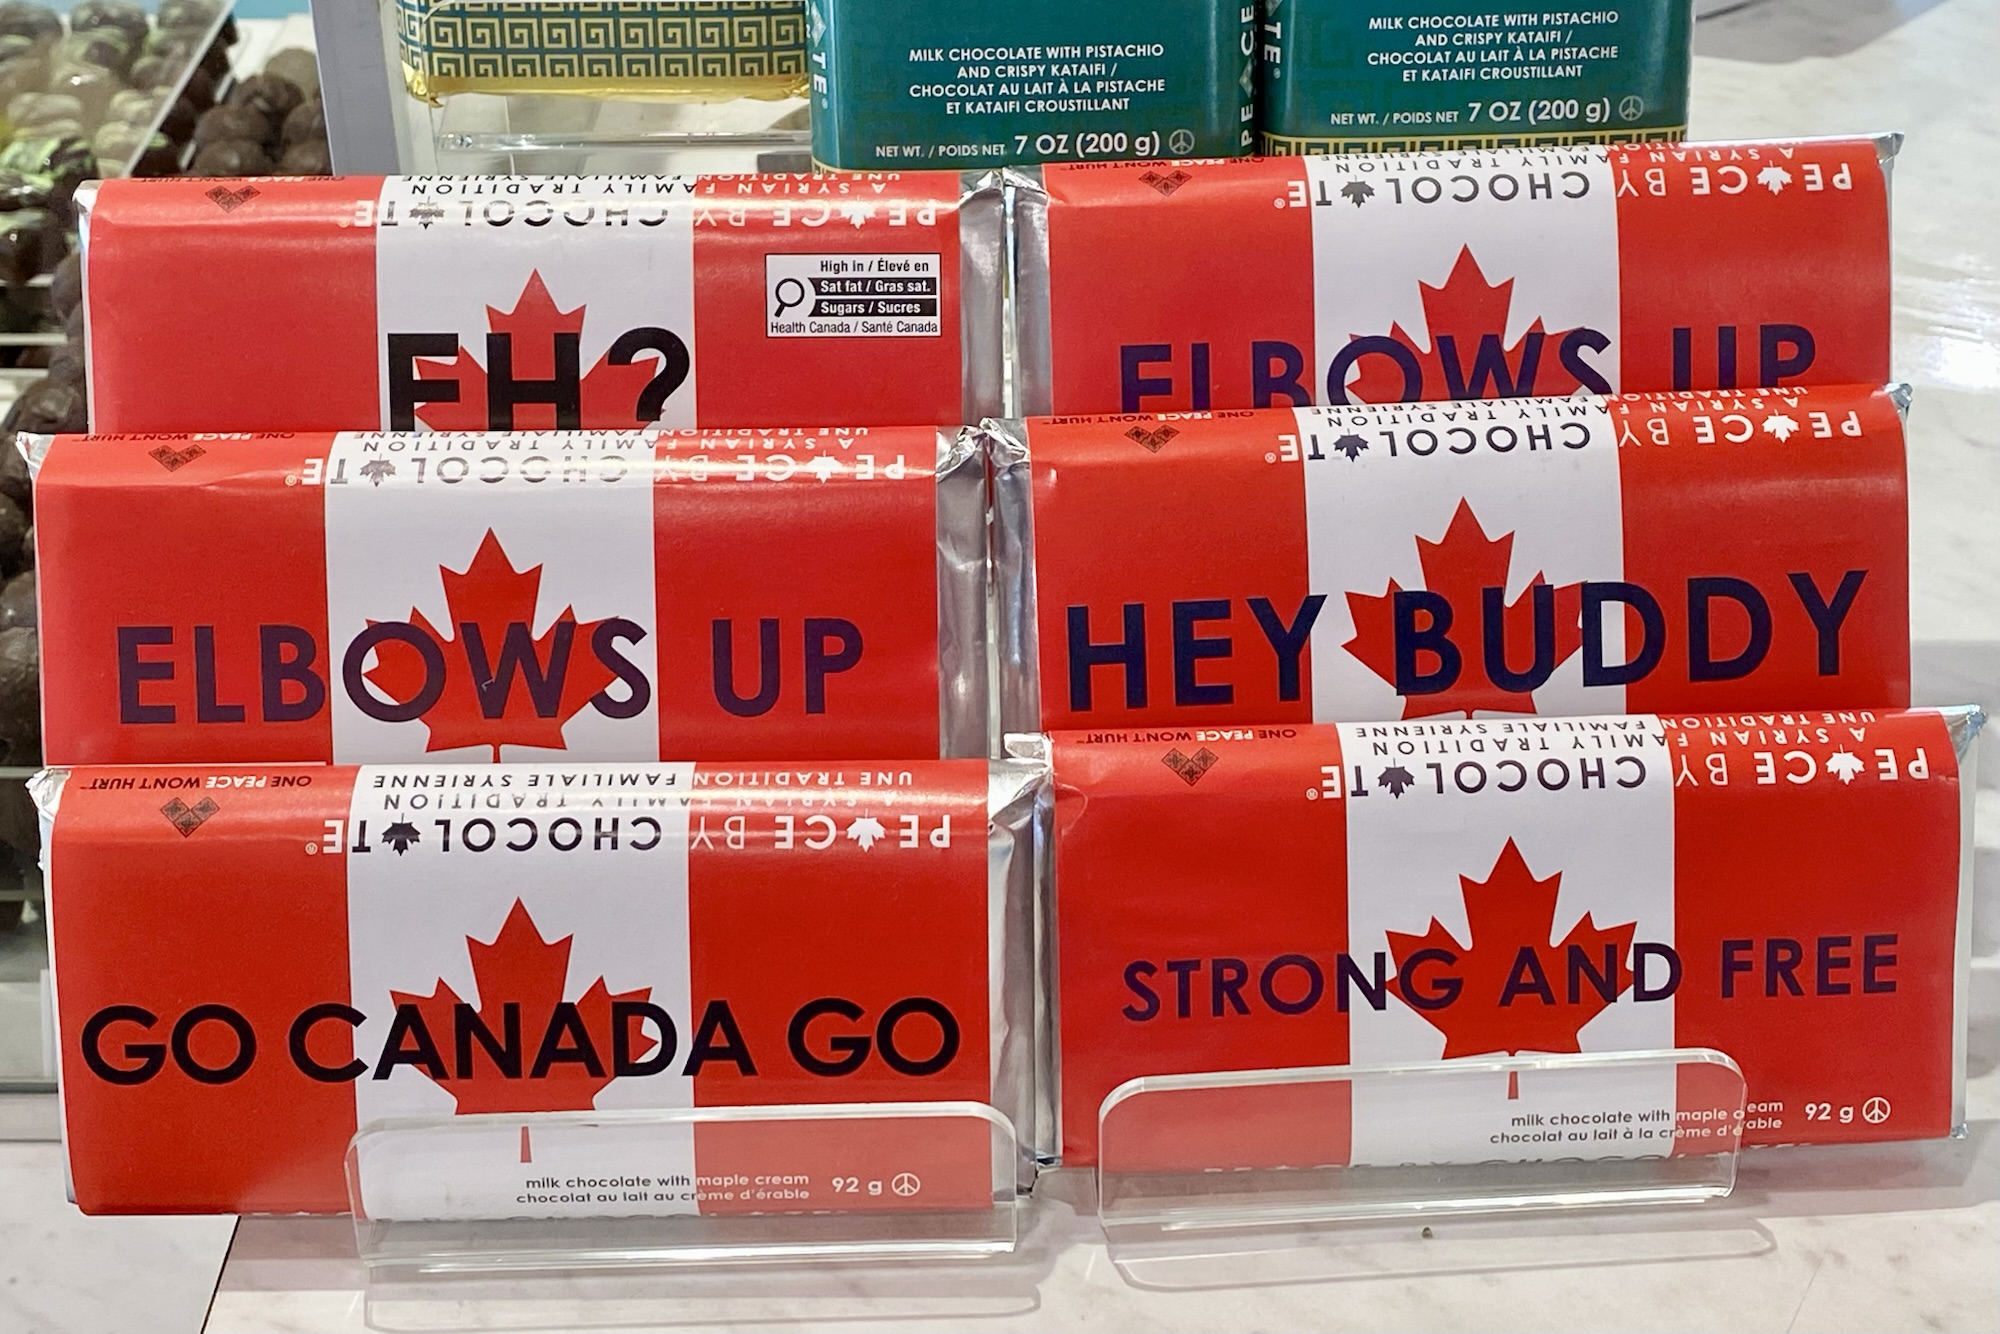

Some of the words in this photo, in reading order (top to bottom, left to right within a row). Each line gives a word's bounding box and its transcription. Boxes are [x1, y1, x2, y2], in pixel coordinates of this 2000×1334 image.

[1368, 15, 1403, 30] MILK
[1407, 14, 1500, 30] CHOCOLATE
[1503, 12, 1540, 27] WITH
[1542, 10, 1619, 26] PISTACHIO
[1414, 32, 1449, 47] AND
[1452, 30, 1504, 46] CRISPY
[1507, 30, 1562, 44] KATAIFI
[908, 47, 944, 62] MILK
[948, 46, 1041, 62] CHOCOLATE
[1046, 44, 1083, 60] WITH
[1086, 44, 1164, 58] PISTACHIO
[1366, 50, 1452, 66] CHOCOLAT
[1455, 50, 1476, 64] AU
[1480, 48, 1510, 63] LAIT
[1512, 44, 1524, 62] À
[1528, 47, 1548, 62] LA
[1550, 45, 1618, 60] PISTACHE
[956, 64, 992, 79] AND
[994, 63, 1046, 78] CRISPY
[1050, 62, 1106, 78] KATAIFI
[1402, 68, 1418, 82] ET
[1420, 66, 1476, 82] KATAIFI
[1480, 64, 1583, 80] CROUSTILLANT
[909, 82, 995, 98] CHOCOLAT
[998, 81, 1020, 96] AU
[1024, 80, 1054, 95] LAIT
[1058, 75, 1069, 94] À
[1074, 79, 1092, 94] LA
[1096, 78, 1166, 93] PISTACHE
[946, 100, 962, 115] ET
[966, 99, 1020, 114] KATAIFI
[1024, 97, 1130, 113] CROUSTILLANT
[1467, 104, 1482, 122] 7
[1488, 102, 1522, 122] OZ
[1528, 100, 1580, 125] (200
[1585, 98, 1612, 124] g)
[1330, 113, 1355, 126] NET
[1356, 112, 1380, 126] WT.
[1392, 110, 1433, 125] POIDS
[1436, 110, 1459, 124] NET
[876, 146, 900, 158] NET
[902, 145, 926, 158] WT.
[938, 144, 978, 158] POIDS
[982, 142, 1005, 156] NET
[1014, 136, 1028, 155] 7
[1034, 134, 1069, 155] OZ
[1075, 132, 1127, 157] (200
[1134, 130, 1161, 157] g)
[1616, 168, 1666, 198] BY
[820, 260, 848, 274] High
[852, 260, 864, 272] in
[877, 257, 910, 272] Élevé
[914, 262, 929, 272] en
[820, 280, 842, 293] Sat
[844, 280, 862, 292] fat
[874, 280, 904, 292] Gras
[906, 280, 931, 292] sat.
[820, 302, 865, 316] Sugars
[877, 300, 921, 314] Sucres
[770, 321, 806, 334] Health
[809, 321, 850, 333] Canada
[862, 320, 893, 333] Santé
[896, 320, 938, 333] Canada
[1650, 398, 1764, 414] SYRIAN
[1786, 397, 1800, 409] A
[1157, 412, 1212, 422] PEACE
[1218, 410, 1254, 420] ONE
[1328, 408, 1496, 428] TRADITION
[1618, 419, 1670, 447] BY
[1066, 594, 1326, 712] HEY
[1394, 569, 1868, 696] BUDDY
[117, 618, 650, 724] ELBOWS
[712, 616, 864, 718] UP
[1660, 713, 1810, 730] TRADITION
[1822, 711, 1876, 724] UNE
[1258, 728, 1298, 740] ONE
[1356, 722, 1488, 738] SYRIENNE
[1503, 720, 1646, 734] FAMILIALE
[1848, 728, 1866, 742] A
[1132, 730, 1192, 742] WON'T
[1195, 730, 1254, 742] PEACE
[1572, 732, 1688, 750] FAMILY
[1710, 728, 1830, 746] SYRIAN
[1372, 737, 1550, 756] TRADITION
[694, 771, 844, 786] TRADITION
[860, 772, 912, 786] UNE
[1674, 753, 1728, 788] BY
[139, 776, 201, 790] WON'T
[205, 776, 267, 790] PEACE
[270, 776, 312, 788] ONE
[374, 774, 511, 788] SYRIENNE
[528, 774, 676, 788] FAMILIALE
[690, 816, 746, 850] BY
[1122, 946, 1464, 1022] STRONG
[1498, 942, 1682, 1008] AND
[1721, 933, 1898, 999] FREE
[81, 1002, 256, 1086] GO
[288, 1000, 758, 1082] CANADA
[787, 996, 960, 1078] GO
[1511, 1112, 1544, 1128] milk
[1550, 1110, 1633, 1126] chocolate
[1638, 1109, 1670, 1123] with
[1676, 1108, 1728, 1123] maple
[1732, 1102, 1784, 1120] ceam
[1804, 1102, 1832, 1121] 92
[1840, 1106, 1854, 1124] g
[1490, 1130, 1563, 1144] chocolat
[1568, 1131, 1588, 1142] au
[1592, 1128, 1618, 1142] lait
[1623, 1126, 1634, 1140] à
[1638, 1126, 1654, 1139] la
[1659, 1125, 1712, 1138] crème
[526, 1176, 560, 1190] milk
[566, 1176, 652, 1188] chocolate
[656, 1175, 690, 1187] with
[696, 1174, 750, 1190] maple
[754, 1174, 810, 1186] cream
[832, 1176, 860, 1193] 92
[868, 1179, 882, 1196] g
[516, 1192, 590, 1204] chocolat
[596, 1193, 618, 1202] au
[623, 1191, 648, 1202] lait
[654, 1192, 675, 1202] au
[680, 1188, 734, 1201] crème
